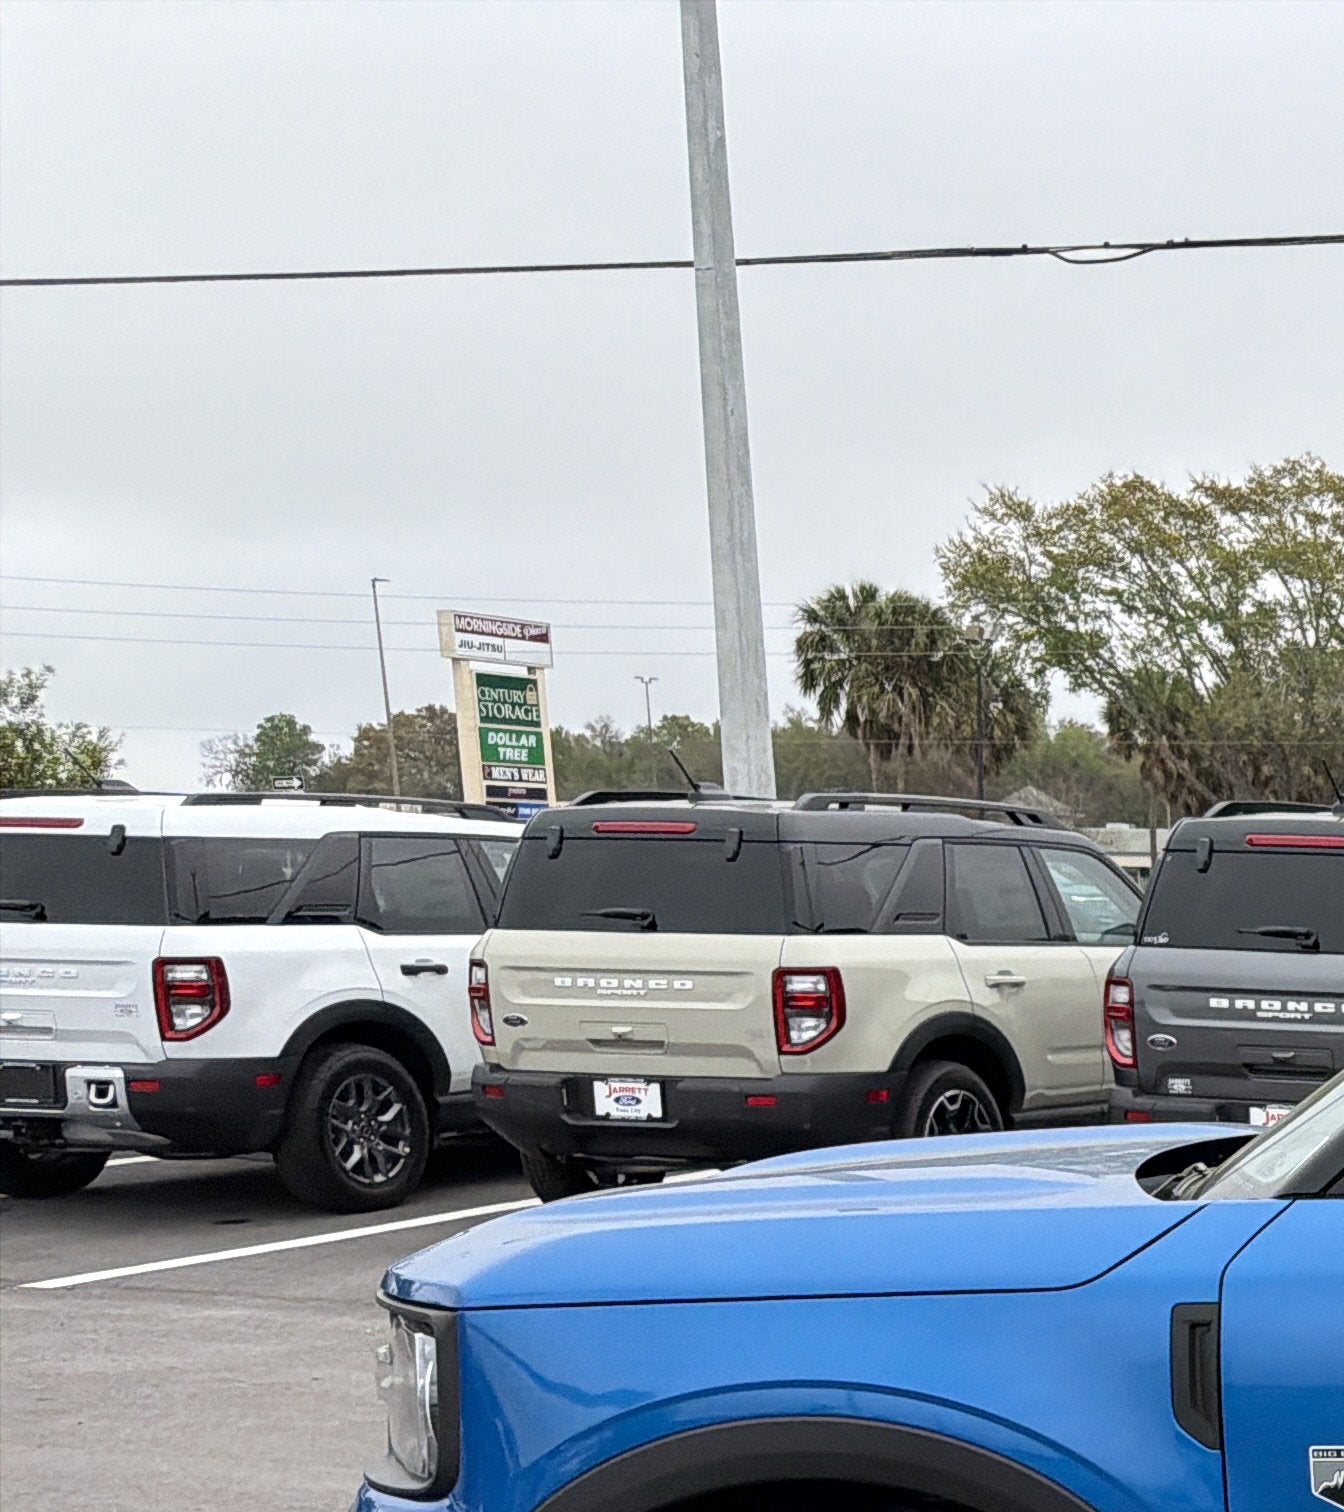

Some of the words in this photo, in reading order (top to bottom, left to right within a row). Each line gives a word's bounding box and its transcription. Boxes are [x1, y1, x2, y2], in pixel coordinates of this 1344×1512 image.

[455, 616, 522, 637] MORNINGSIDE
[458, 640, 503, 653] JIU-JITSU
[478, 686, 525, 703] CENTURY
[480, 701, 540, 721] STORAGE
[487, 732, 537, 747] DOLLAR
[498, 747, 529, 761] TREE
[491, 767, 520, 780] MEN'S
[520, 768, 546, 782] WEAR
[554, 976, 694, 989] BRONCO
[1256, 1011, 1314, 1020] SPORT
[605, 1084, 650, 1098] JARRETT
